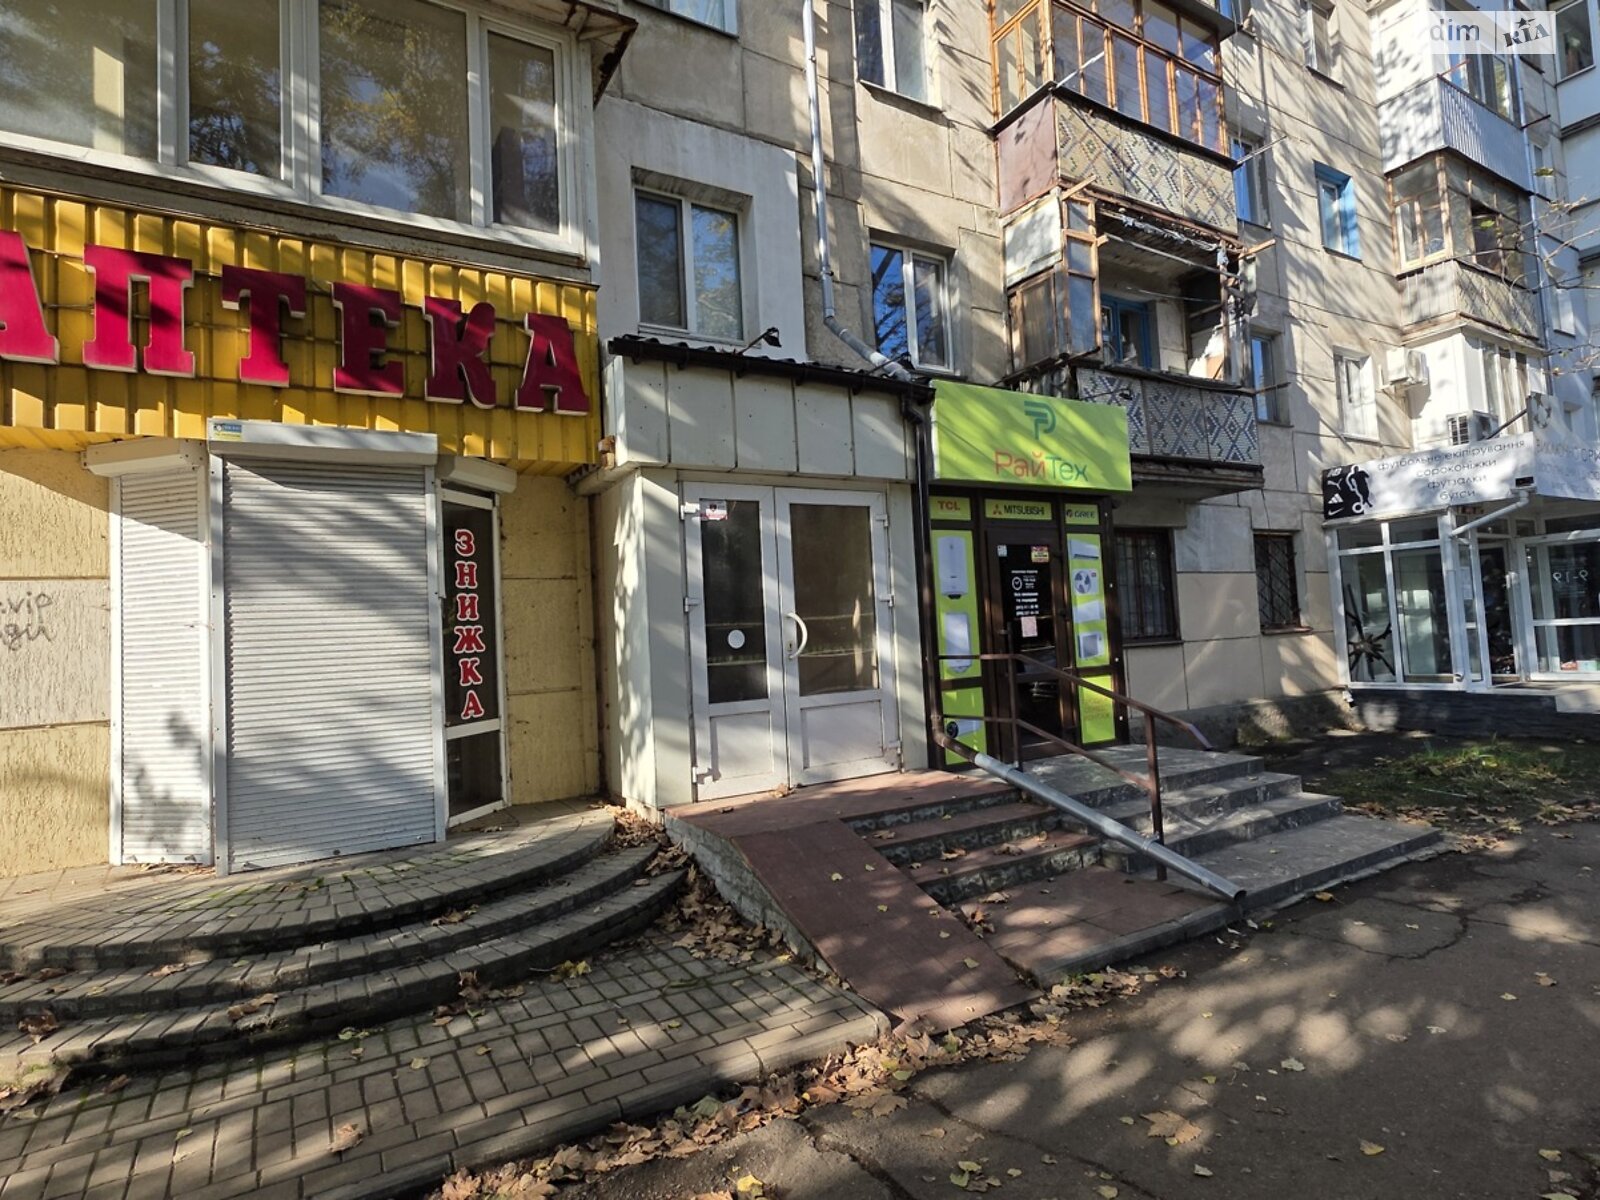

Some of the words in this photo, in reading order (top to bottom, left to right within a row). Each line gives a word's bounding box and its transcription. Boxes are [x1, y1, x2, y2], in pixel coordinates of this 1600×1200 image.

[993, 449, 1089, 482] РайТех
[937, 500, 961, 511] TCL
[1004, 504, 1045, 516] MITSUBISHI
[453, 528, 485, 720] ЗНИЖКА
